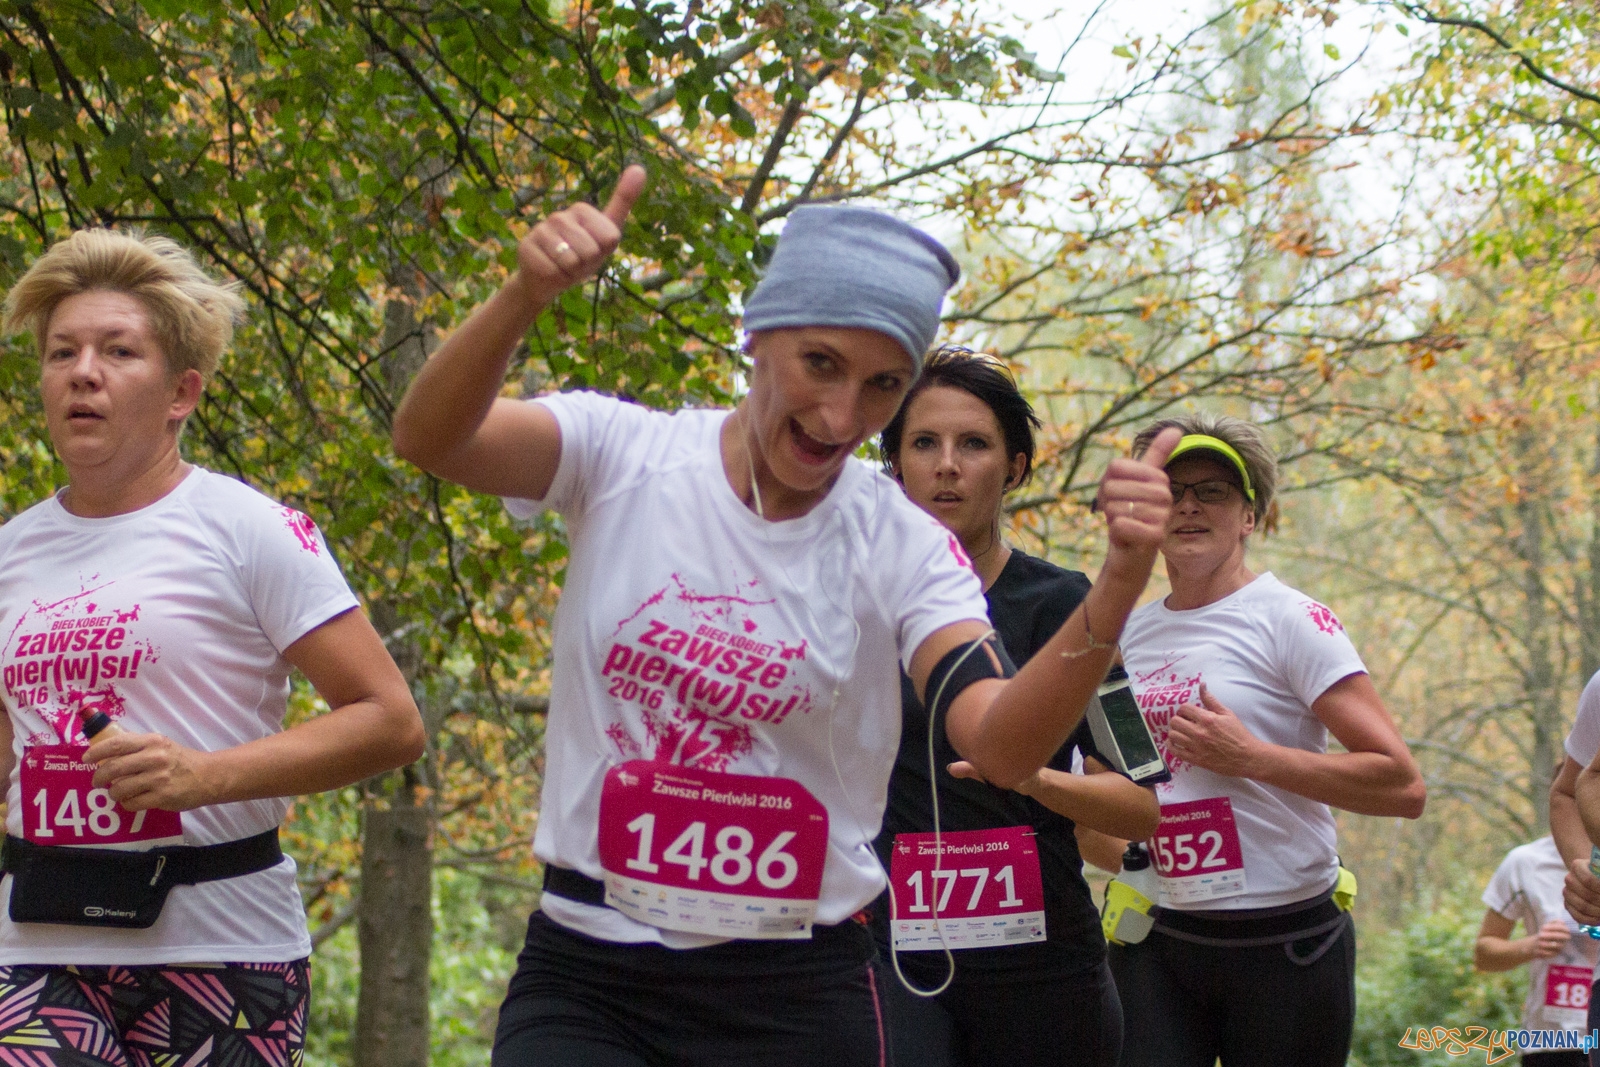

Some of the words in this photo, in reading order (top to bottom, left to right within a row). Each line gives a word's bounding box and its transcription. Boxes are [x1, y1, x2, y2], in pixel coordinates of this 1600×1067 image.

[51, 620, 74, 630] BIEG
[75, 616, 114, 628] KOBIET
[15, 627, 125, 658] zawsze
[637, 619, 788, 689] zawsze
[696, 624, 727, 643] BIEG
[727, 634, 775, 657] KOBIET
[4, 649, 143, 697] pier(w)si!
[602, 643, 799, 725] pier(w)si!
[15, 686, 49, 709] 2016
[609, 676, 665, 709] 2016
[44, 760, 68, 771] Zawsze
[652, 779, 700, 800] Zawsze
[702, 788, 757, 808] Pier(w)si
[759, 794, 793, 810] 2016
[1191, 810, 1212, 820] 2016
[626, 812, 799, 890] 1486
[918, 846, 946, 855] Zawsze
[947, 844, 984, 855] Pier(w)si
[985, 841, 1010, 852] 2016
[906, 865, 1024, 913] 1771
[104, 908, 137, 919] Kalenji
[1553, 982, 1589, 1008] 18
